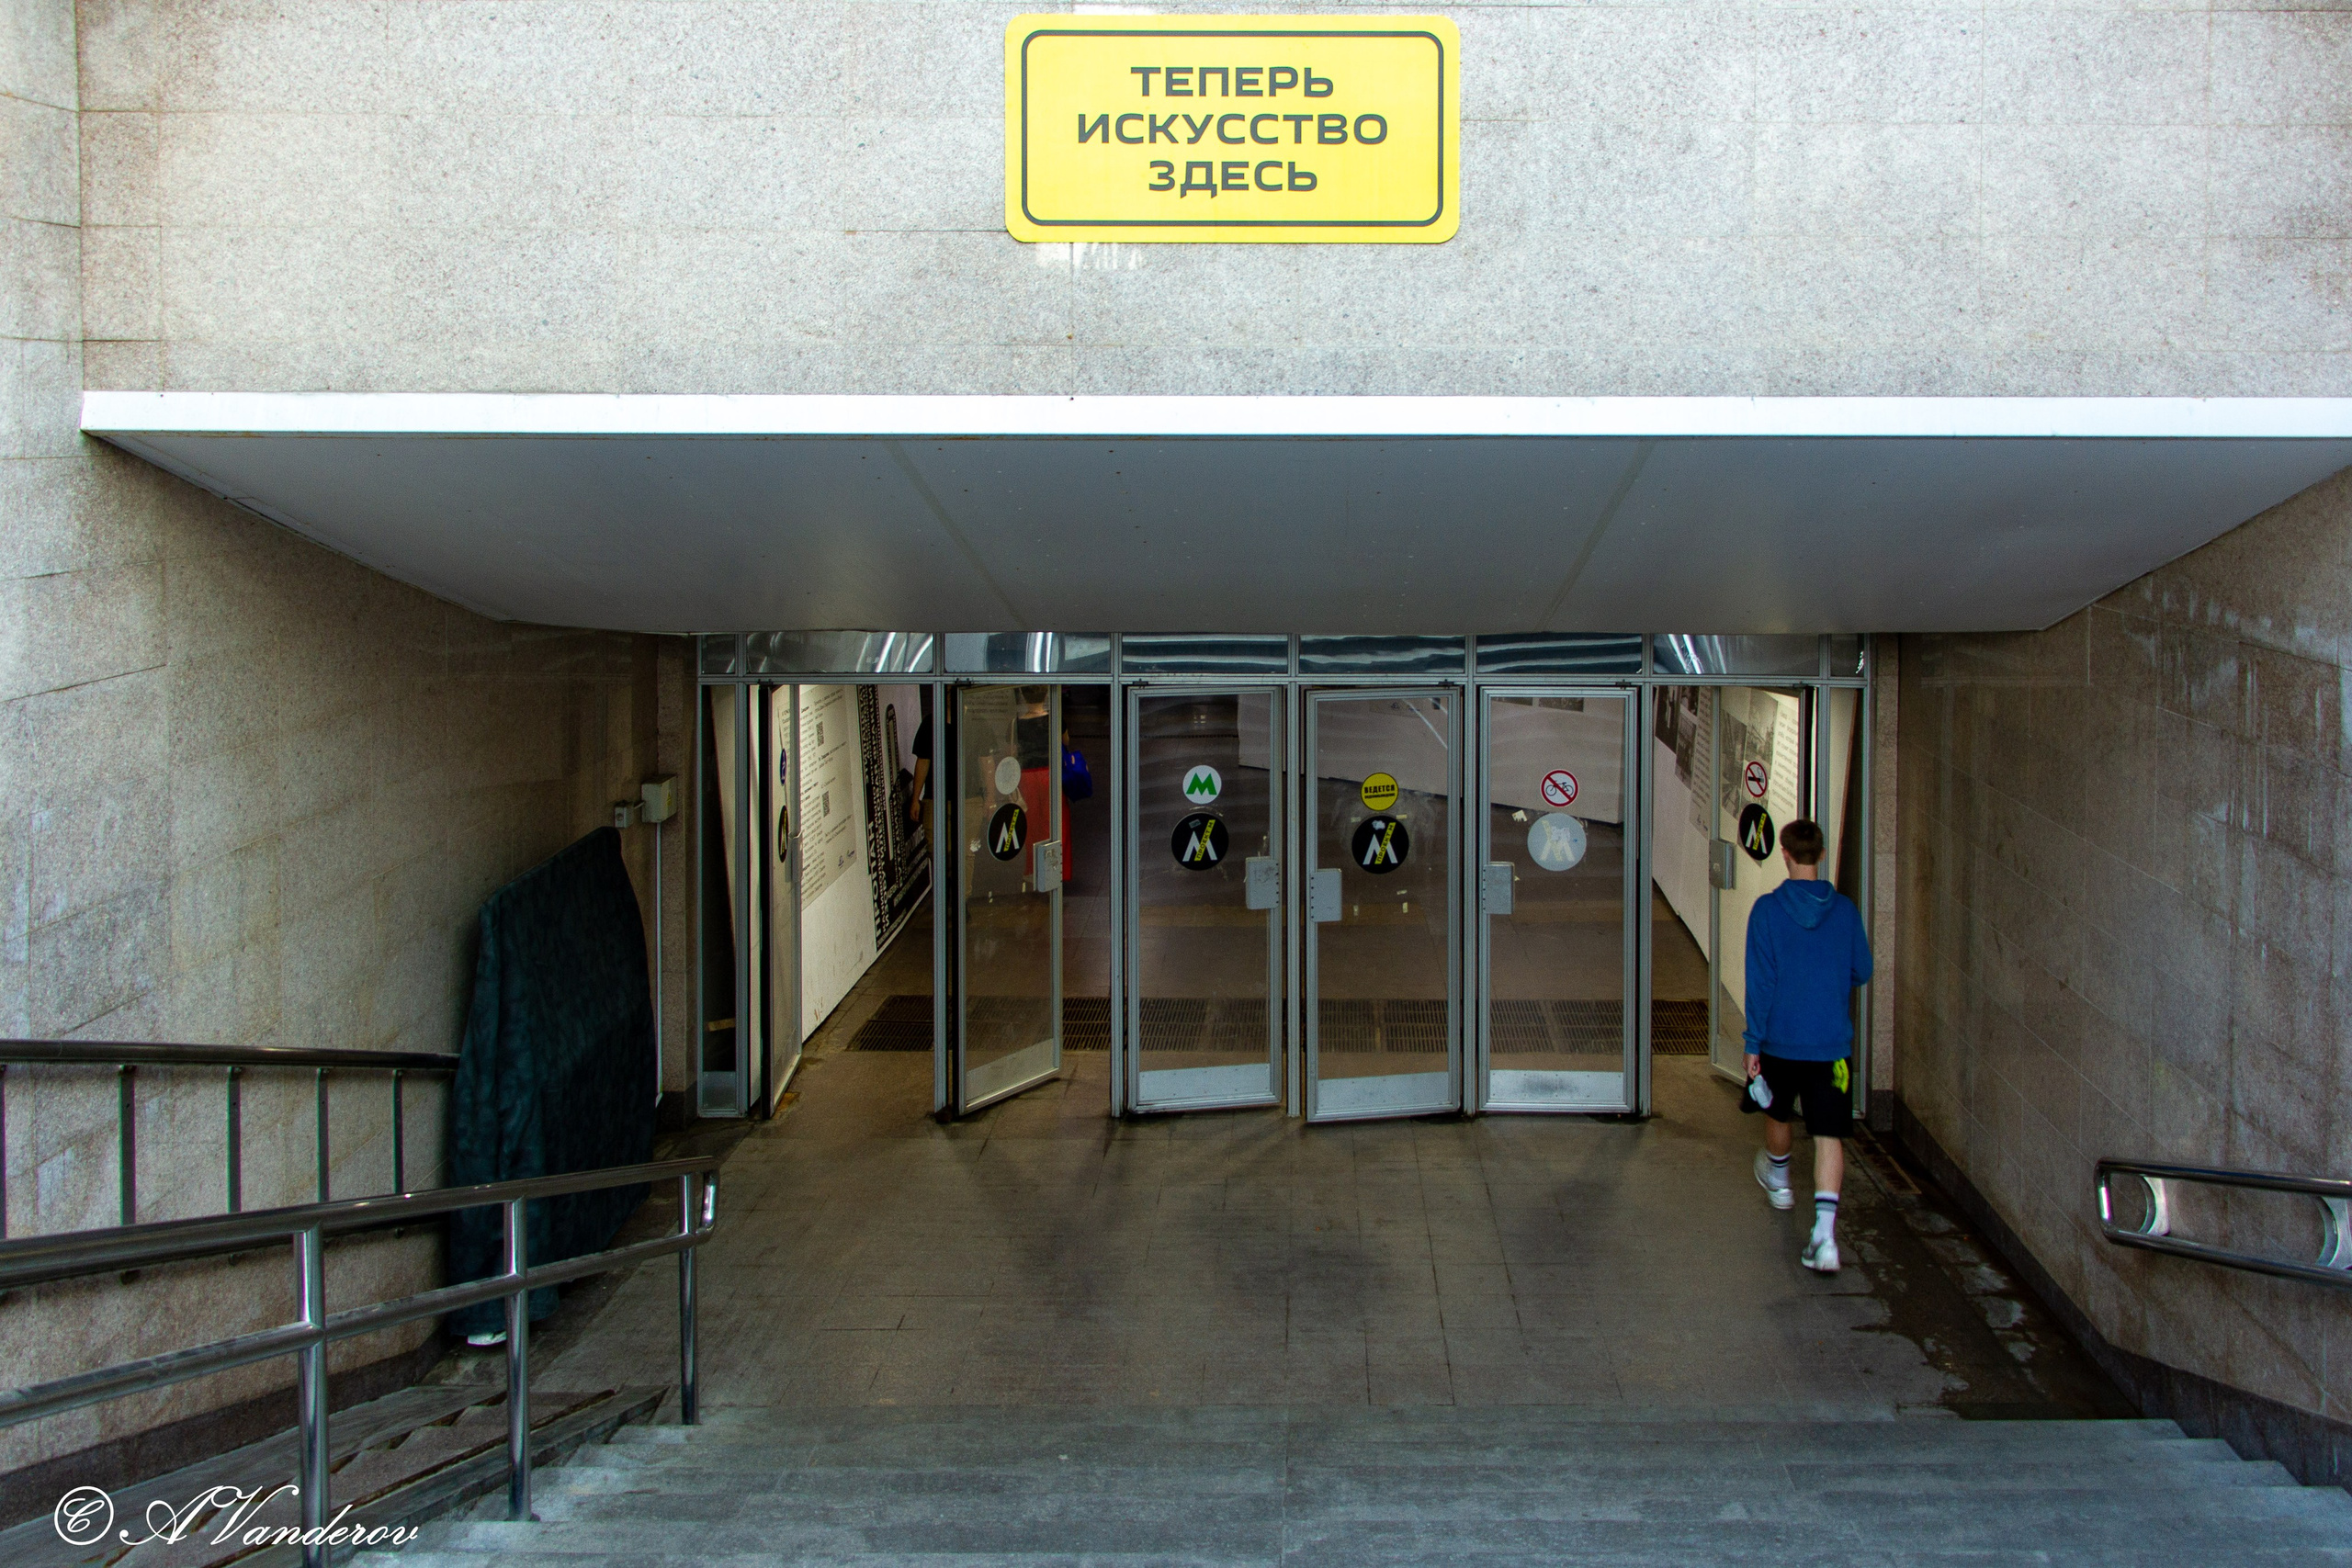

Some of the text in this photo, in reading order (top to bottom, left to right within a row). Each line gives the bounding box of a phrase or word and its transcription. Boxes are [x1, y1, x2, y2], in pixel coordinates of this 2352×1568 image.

[1131, 67, 1334, 97] ТЕПЕРЬ
[1078, 113, 1388, 144] ИСКУССТВО
[1148, 161, 1317, 198] ЗДЕСЬ
[1363, 784, 1396, 794] ВЕДЕТСЯ
[1196, 829, 1210, 860] ПРОЕКТ
[1376, 832, 1391, 863] ПРОЕКТ
